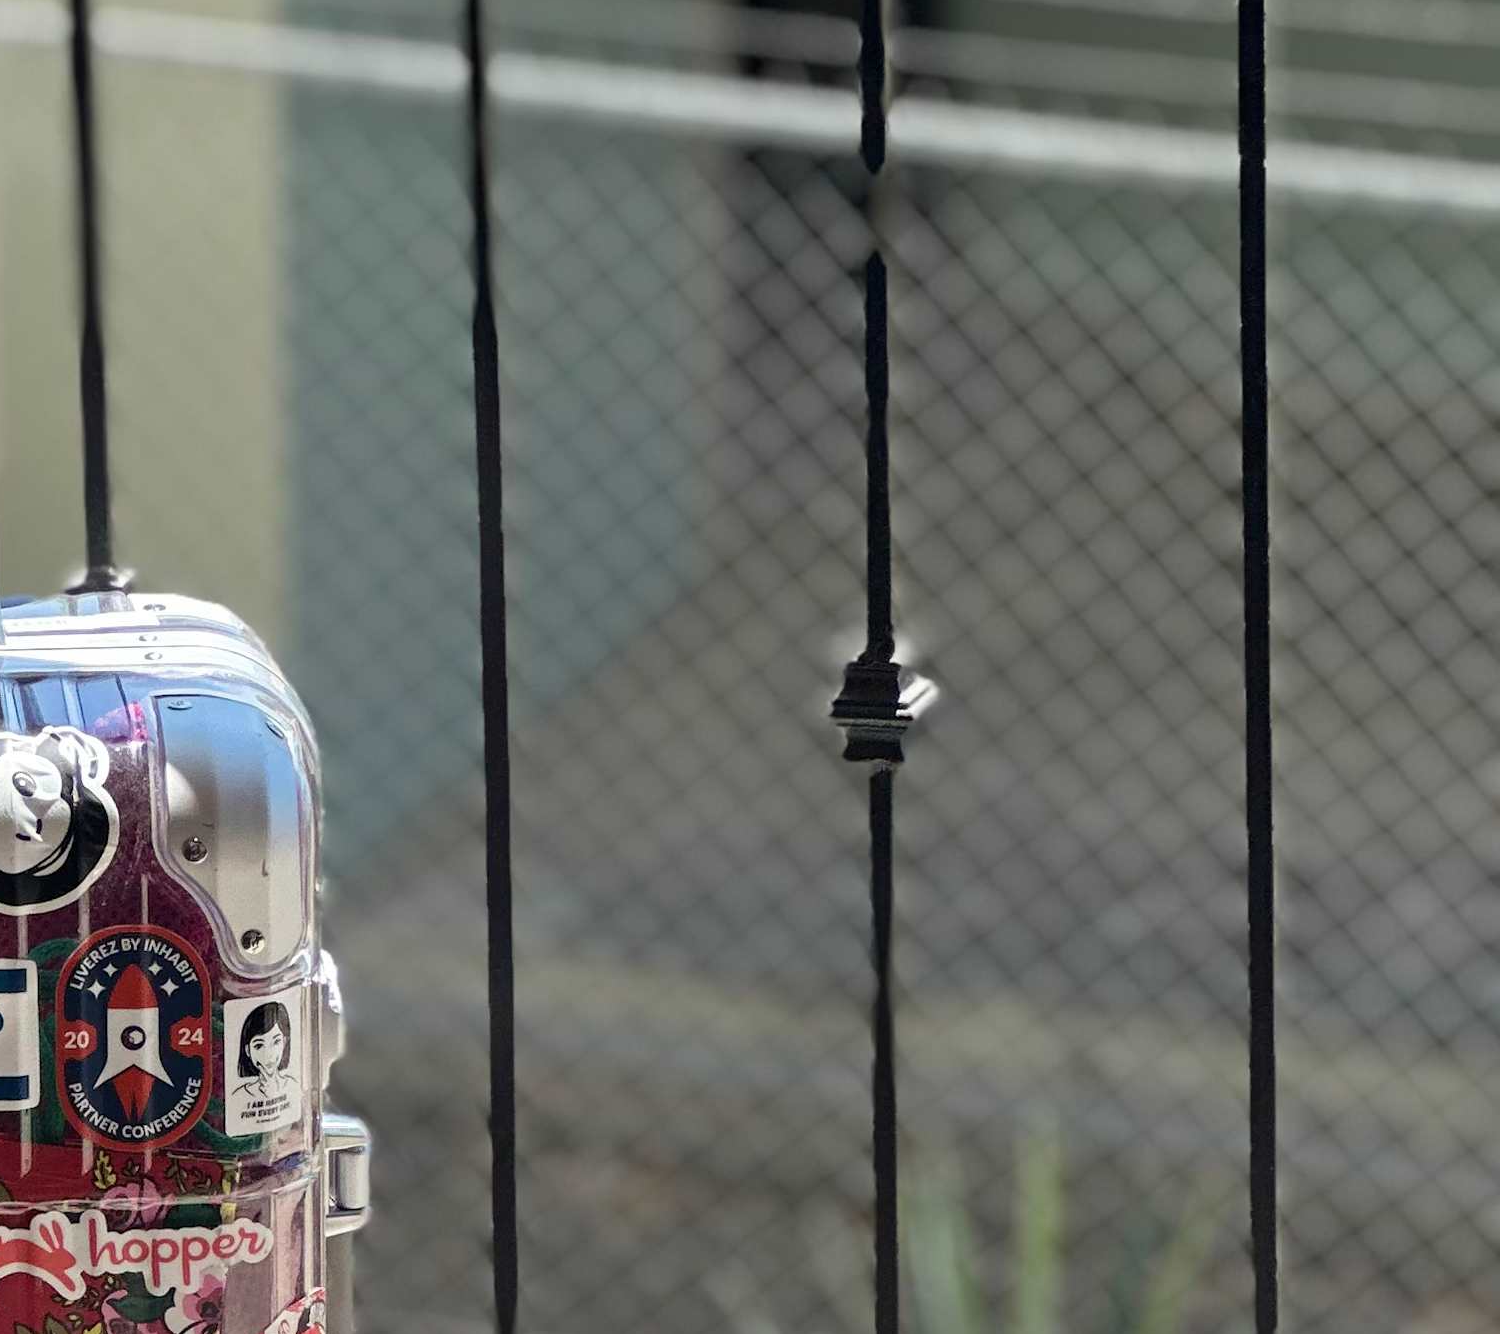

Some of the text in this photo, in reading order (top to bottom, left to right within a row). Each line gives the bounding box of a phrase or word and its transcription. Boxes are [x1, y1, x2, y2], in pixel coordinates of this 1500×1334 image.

[70, 938, 198, 990] LIVEREZ BY INHABIT
[64, 1027, 204, 1049] 20 24
[68, 1077, 202, 1139] PARTNER CONFERENCE
[88, 1218, 264, 1288] hopper
